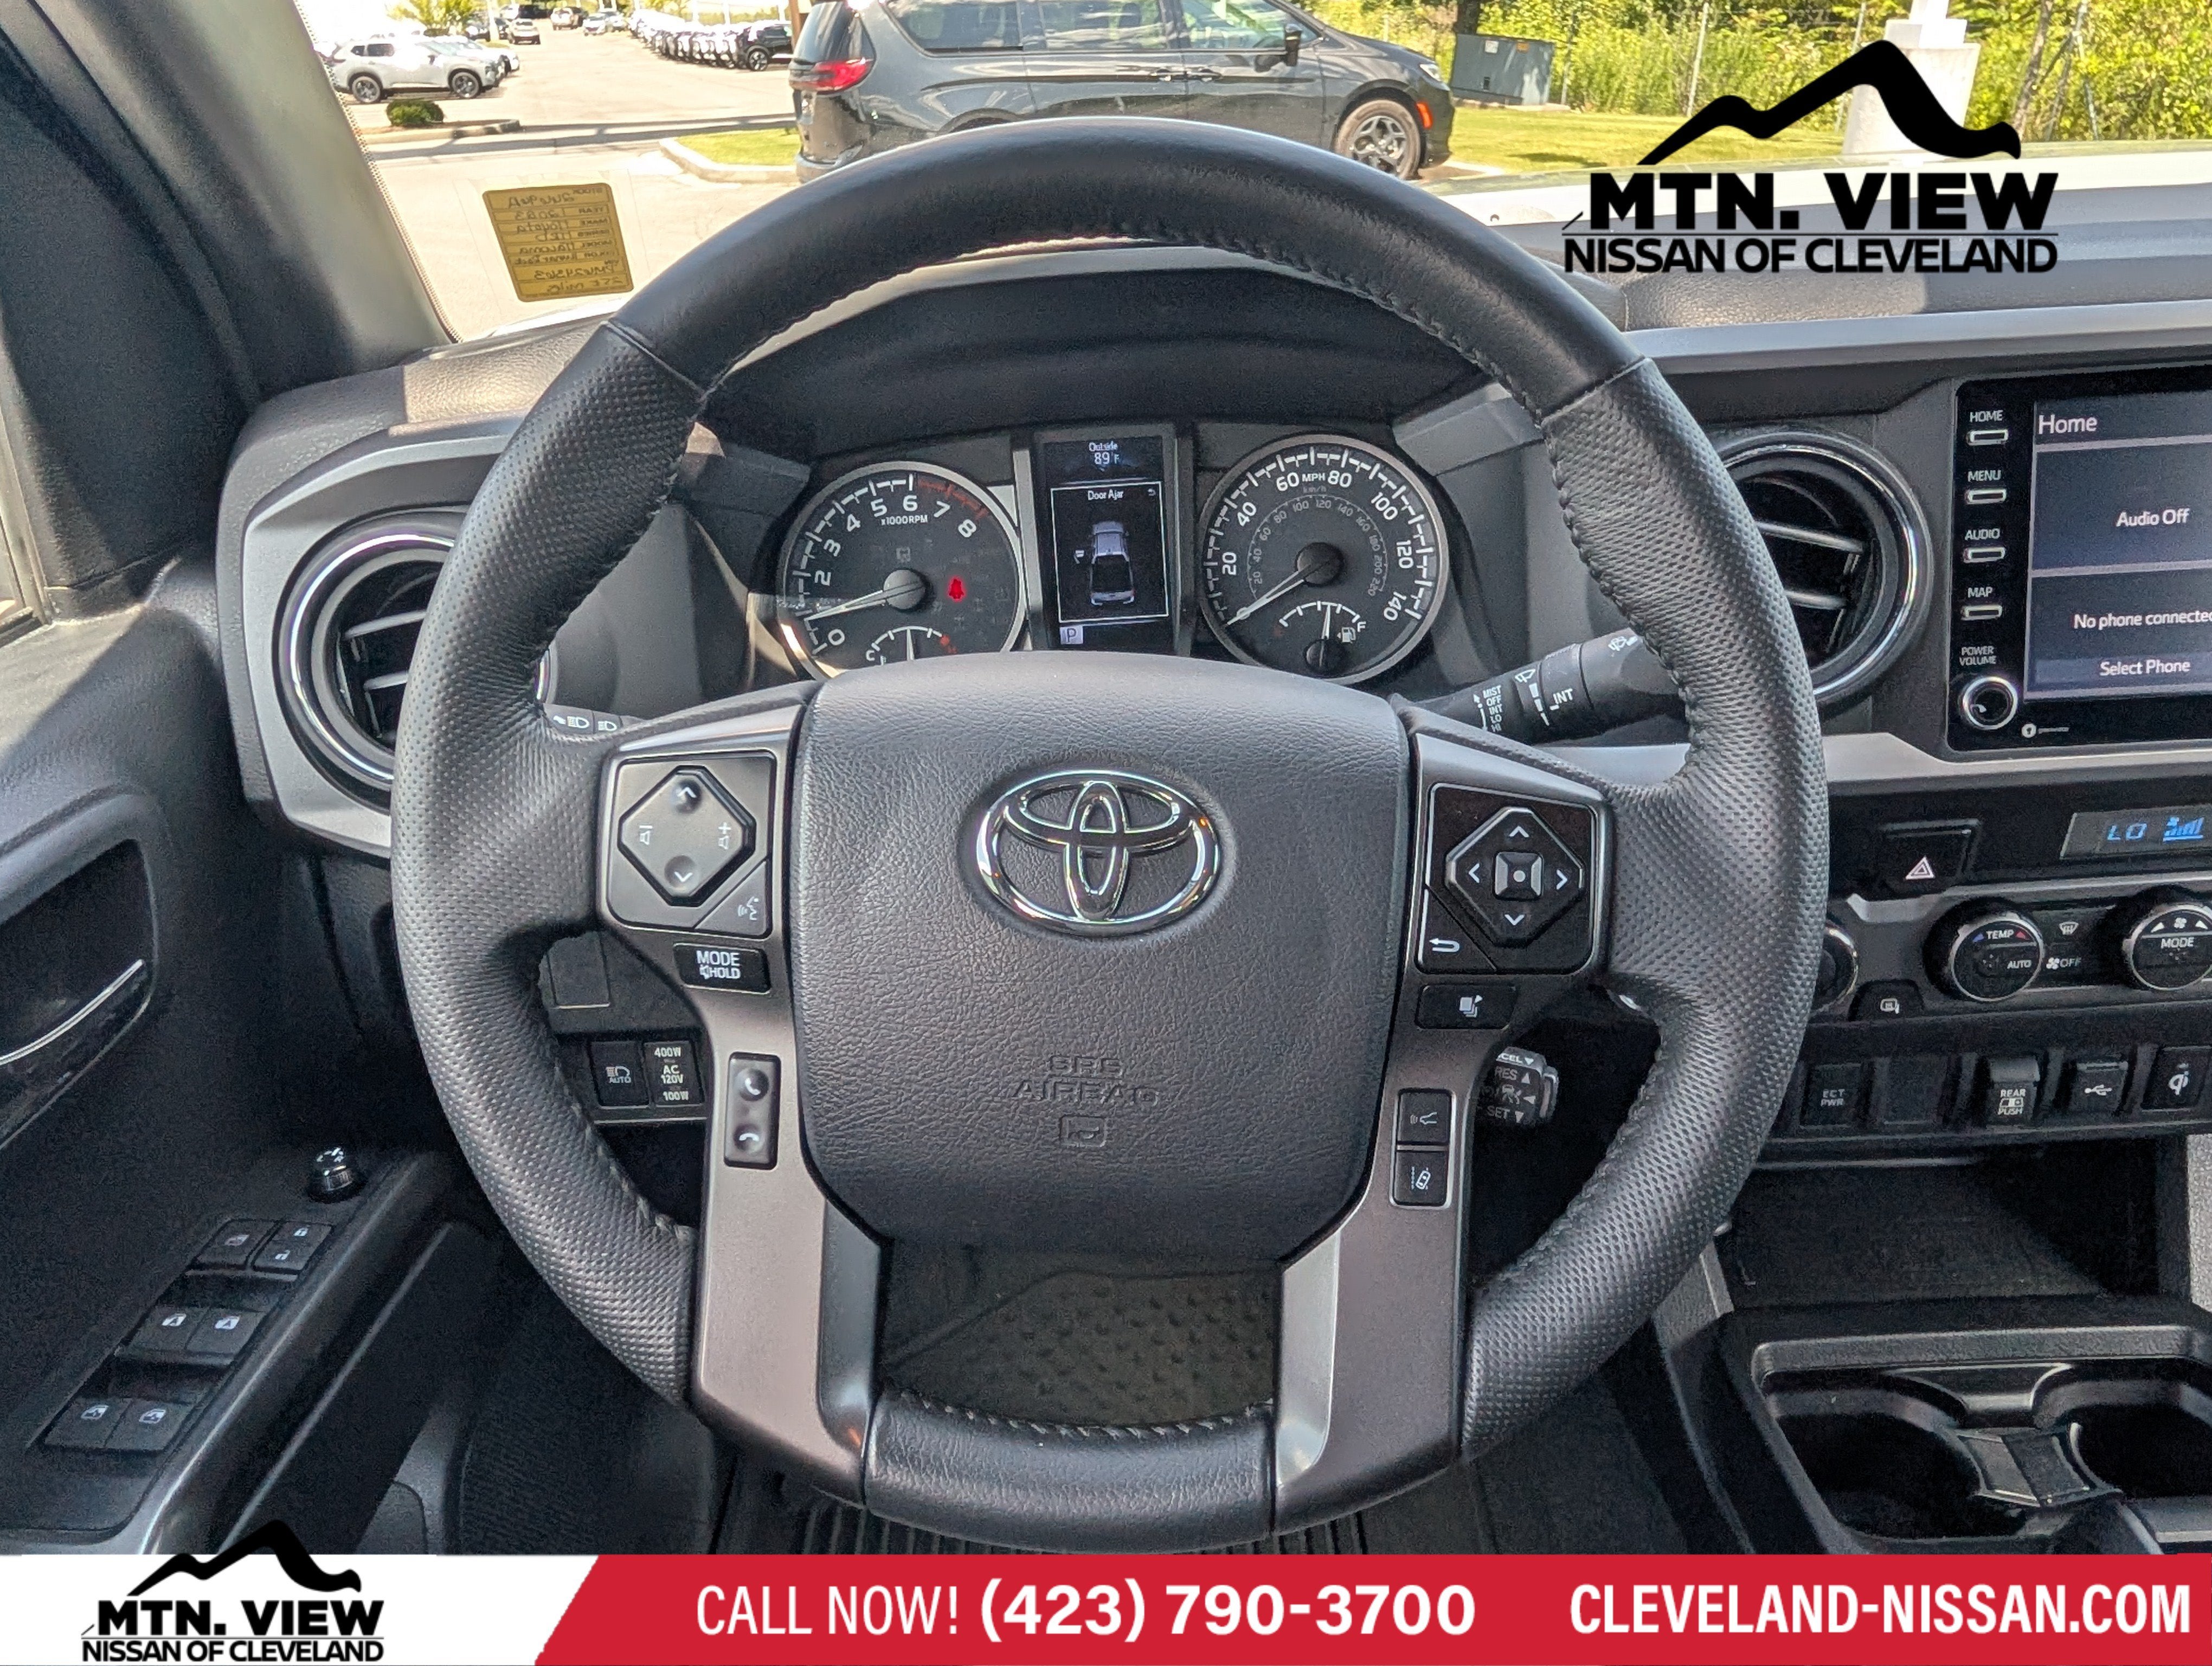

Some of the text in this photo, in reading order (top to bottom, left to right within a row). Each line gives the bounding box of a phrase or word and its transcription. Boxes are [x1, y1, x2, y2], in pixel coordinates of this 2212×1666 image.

[1970, 411, 2003, 423] HOME
[2038, 414, 2097, 435] Home
[1089, 441, 1118, 453] Outside
[1276, 472, 1300, 491] 60
[1302, 472, 1326, 483] MPH
[1328, 470, 1352, 488] 80
[1967, 470, 2001, 482] MENU
[1088, 489, 1124, 500] Door Ajar
[871, 498, 888, 517] 5
[902, 495, 918, 511] 6
[933, 501, 951, 518] 7
[1292, 500, 1310, 514] 100
[1315, 499, 1332, 510] 120
[1337, 503, 1354, 517] 140
[1370, 491, 1399, 521] 100
[1237, 502, 1257, 527] 40
[1273, 510, 1288, 524] 80
[2116, 508, 2190, 527] Audio Off
[846, 515, 861, 532] 4
[957, 518, 977, 538] 8
[1355, 517, 1371, 532] 160
[1259, 527, 1271, 542] 60
[1965, 528, 2001, 541] AUDIO
[823, 539, 841, 557] 3
[1368, 534, 1380, 552] 180
[1253, 548, 1262, 563] 40
[1396, 540, 1414, 569] 120
[1221, 552, 1237, 576] 20
[1373, 555, 1382, 575] 200
[814, 570, 832, 586] 2
[1253, 571, 1263, 585] 20
[1367, 578, 1382, 597] 220
[1967, 586, 1994, 598] MAP
[1382, 591, 1407, 621] 140
[2074, 613, 2097, 629] No
[2098, 613, 2143, 630] phone
[827, 628, 845, 646] 0
[1066, 627, 1077, 643] P
[1961, 645, 1995, 656] POWER
[1959, 655, 1997, 667] VOLUME
[2100, 659, 2191, 676] Select Phone
[1482, 684, 1502, 699] MIST
[1553, 688, 1574, 704] INT
[1486, 695, 1502, 707] OFF
[1488, 705, 1503, 716] INT
[1986, 929, 2014, 940] TEMP
[2160, 937, 2195, 949] MODE
[696, 950, 740, 966] MODE
[2007, 959, 2032, 970] AUTO
[2060, 957, 2082, 968] OFF
[709, 966, 741, 979] HOLD
[654, 1046, 682, 1058] 400W
[663, 1064, 680, 1075] AC
[608, 1075, 632, 1084] AUTO
[660, 1074, 684, 1085] 120V
[663, 1090, 689, 1101] 100W
[1822, 1089, 1844, 1098] ECT
[1999, 1088, 2026, 1098] REAR
[1487, 1105, 1510, 1119] SET
[1997, 1107, 2023, 1116] PUSH
